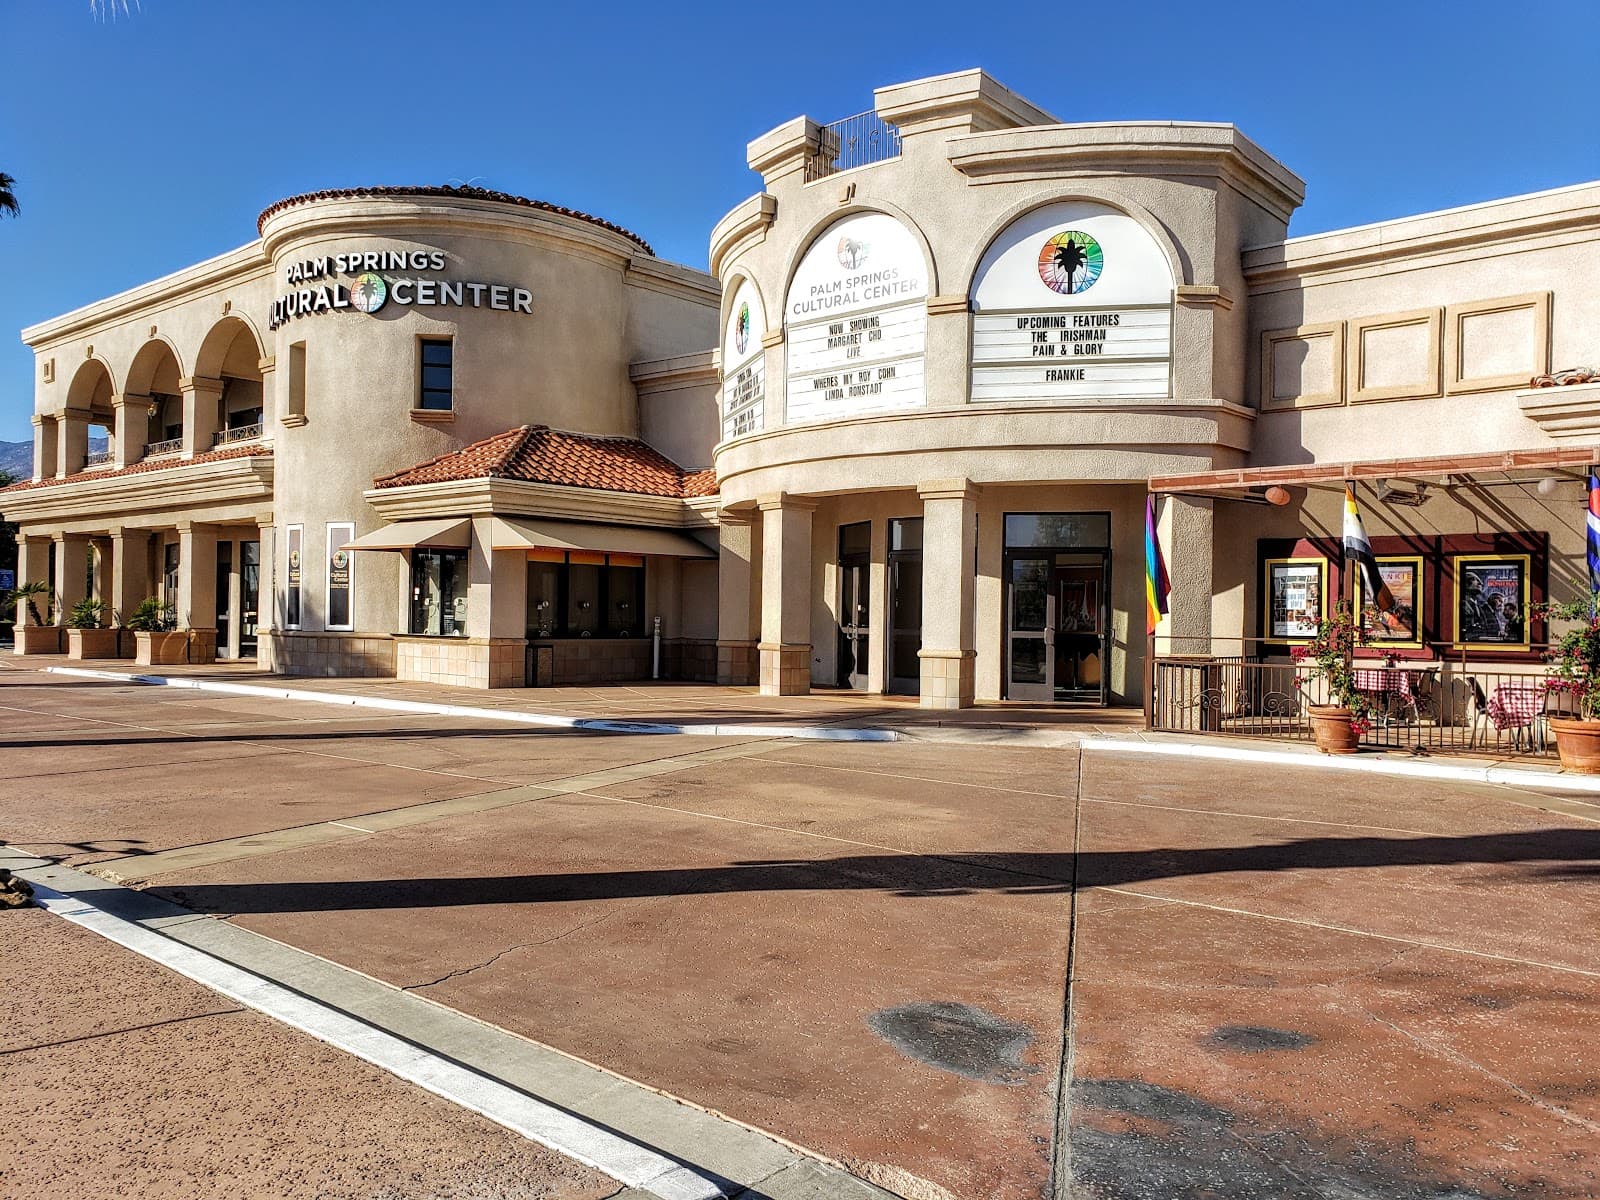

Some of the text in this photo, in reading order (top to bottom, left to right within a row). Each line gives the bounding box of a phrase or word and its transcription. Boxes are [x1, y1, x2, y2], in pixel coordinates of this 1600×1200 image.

[286, 250, 445, 283] PALM SPRINGS
[810, 267, 898, 296] PALM SPRINGS
[269, 280, 533, 327] ULTURAL CENTER
[793, 279, 918, 315] CULTURAL CENTER
[829, 316, 880, 335] NOW SHOWING
[1017, 314, 1120, 329] UPCOMING FEATURES
[828, 329, 881, 349] MARGARET CHO
[1031, 329, 1106, 343] THE IRISHMAN
[846, 346, 860, 358] LIVE
[1032, 343, 1103, 356] PAIN & GLORY
[814, 366, 896, 389] WHERES MY ROY COHN
[1045, 369, 1085, 381] FRANKIE
[825, 382, 883, 400] LINDA RONSTADT
